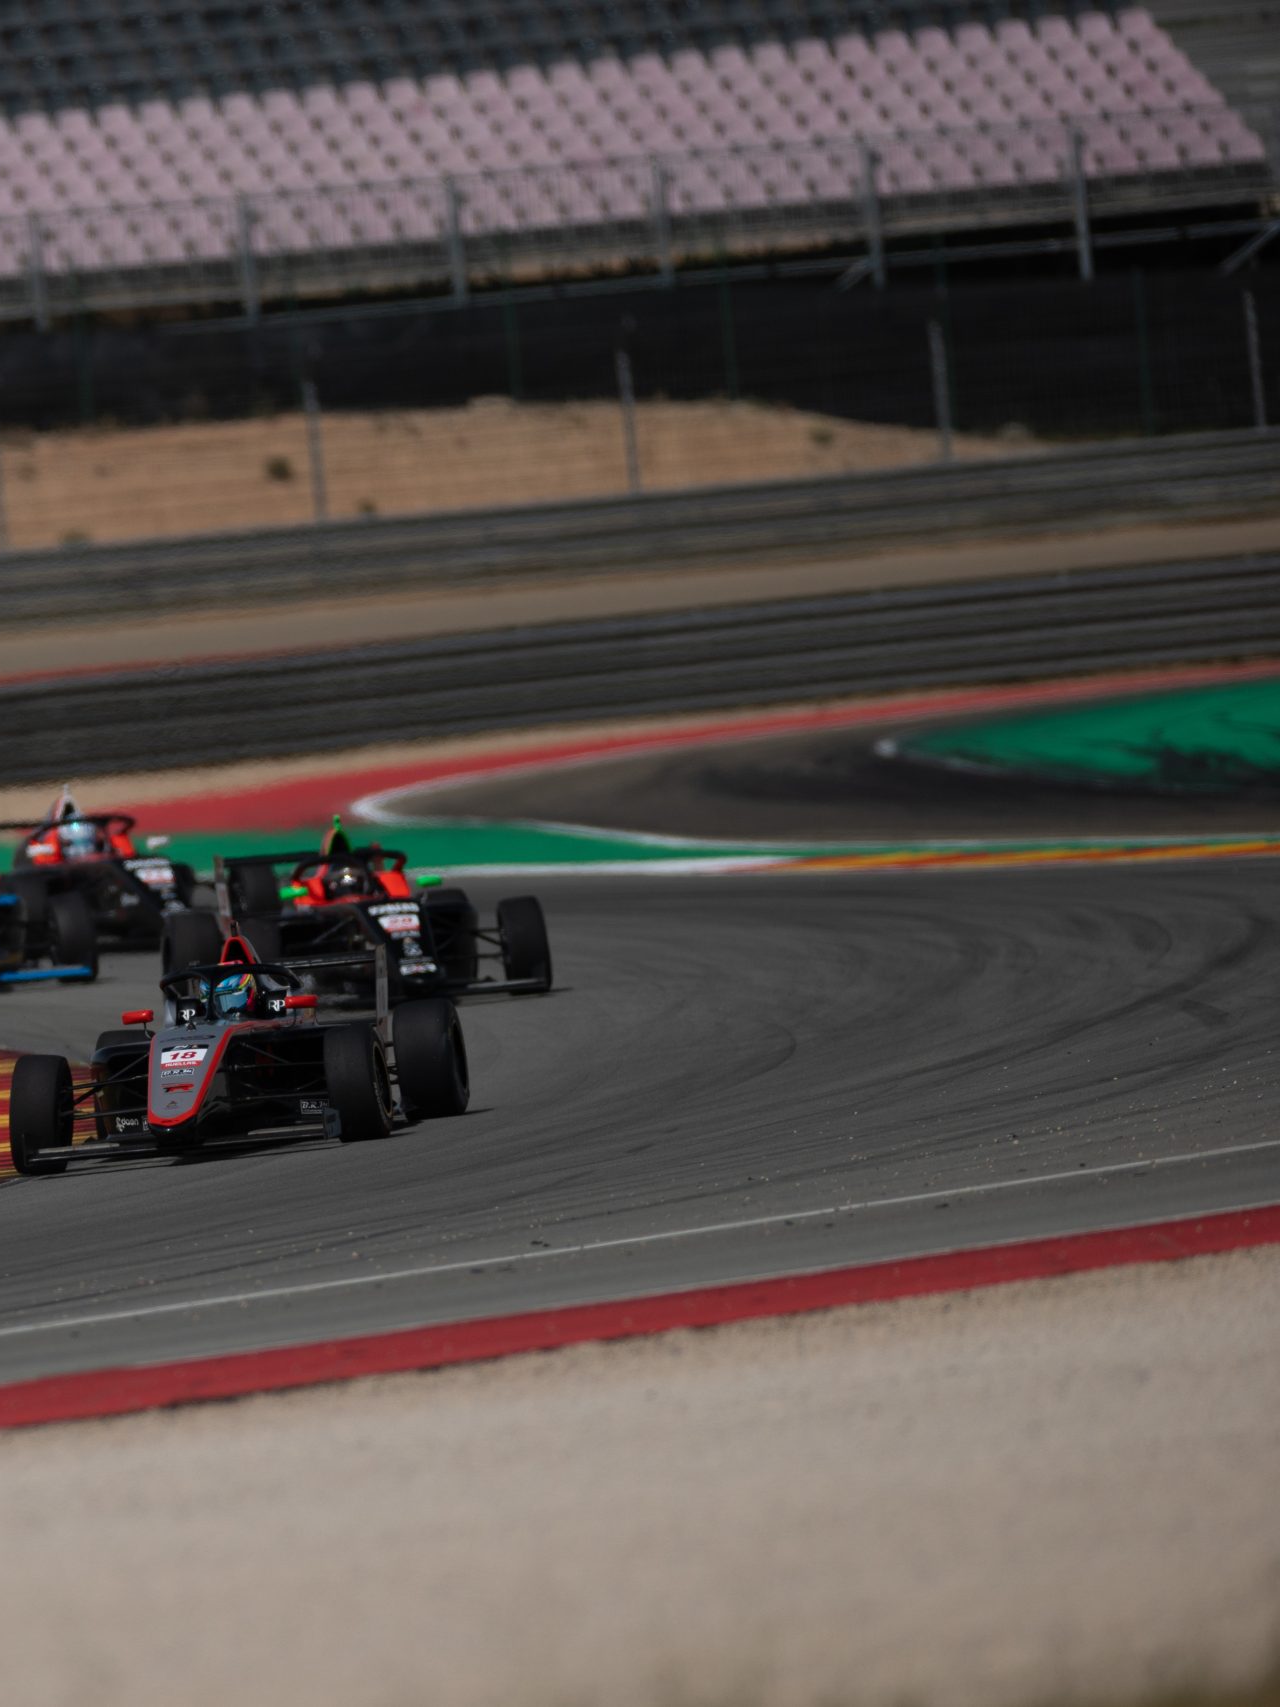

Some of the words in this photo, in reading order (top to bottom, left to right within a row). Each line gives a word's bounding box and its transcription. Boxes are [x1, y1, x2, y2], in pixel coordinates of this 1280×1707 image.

[267, 999, 286, 1012] RP
[179, 1008, 196, 1021] RP
[171, 1051, 197, 1060] 18
